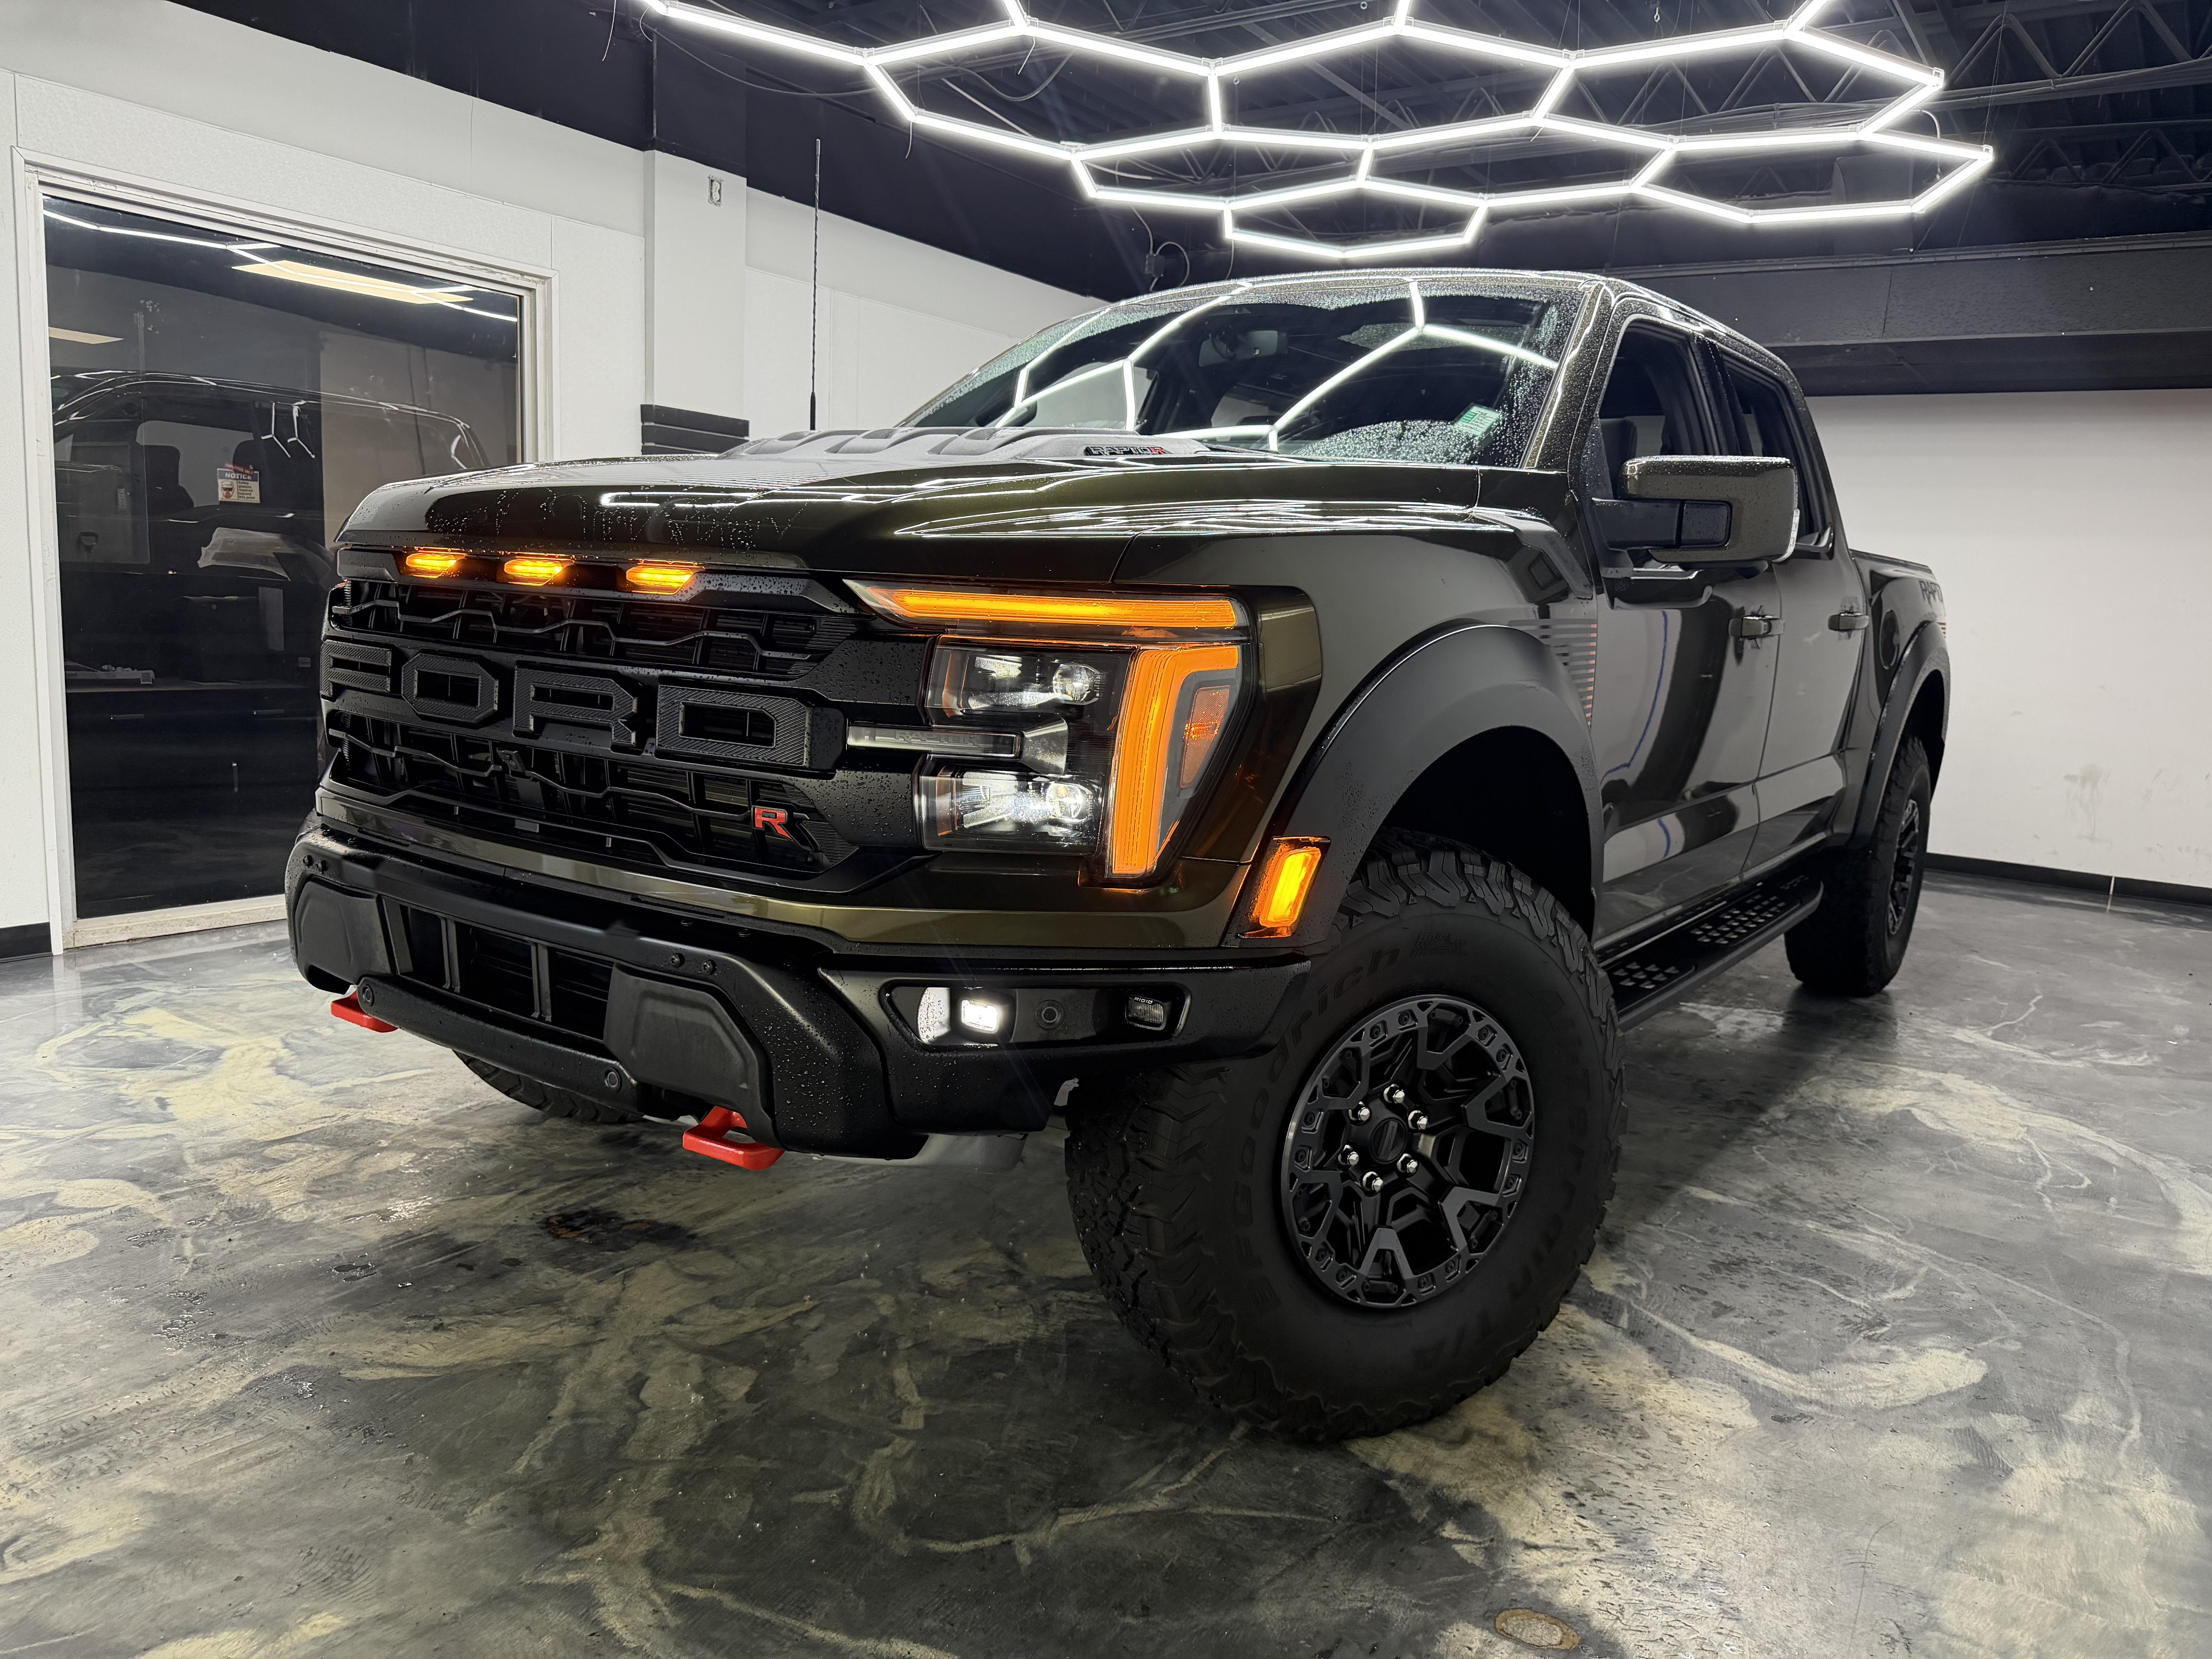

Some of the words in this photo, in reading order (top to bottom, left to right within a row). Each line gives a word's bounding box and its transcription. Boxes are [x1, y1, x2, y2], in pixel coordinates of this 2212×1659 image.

[1090, 446, 1165, 455] RAPTOR
[320, 639, 811, 768] FORD
[894, 730, 980, 747] RAPTOR
[753, 805, 793, 841] R
